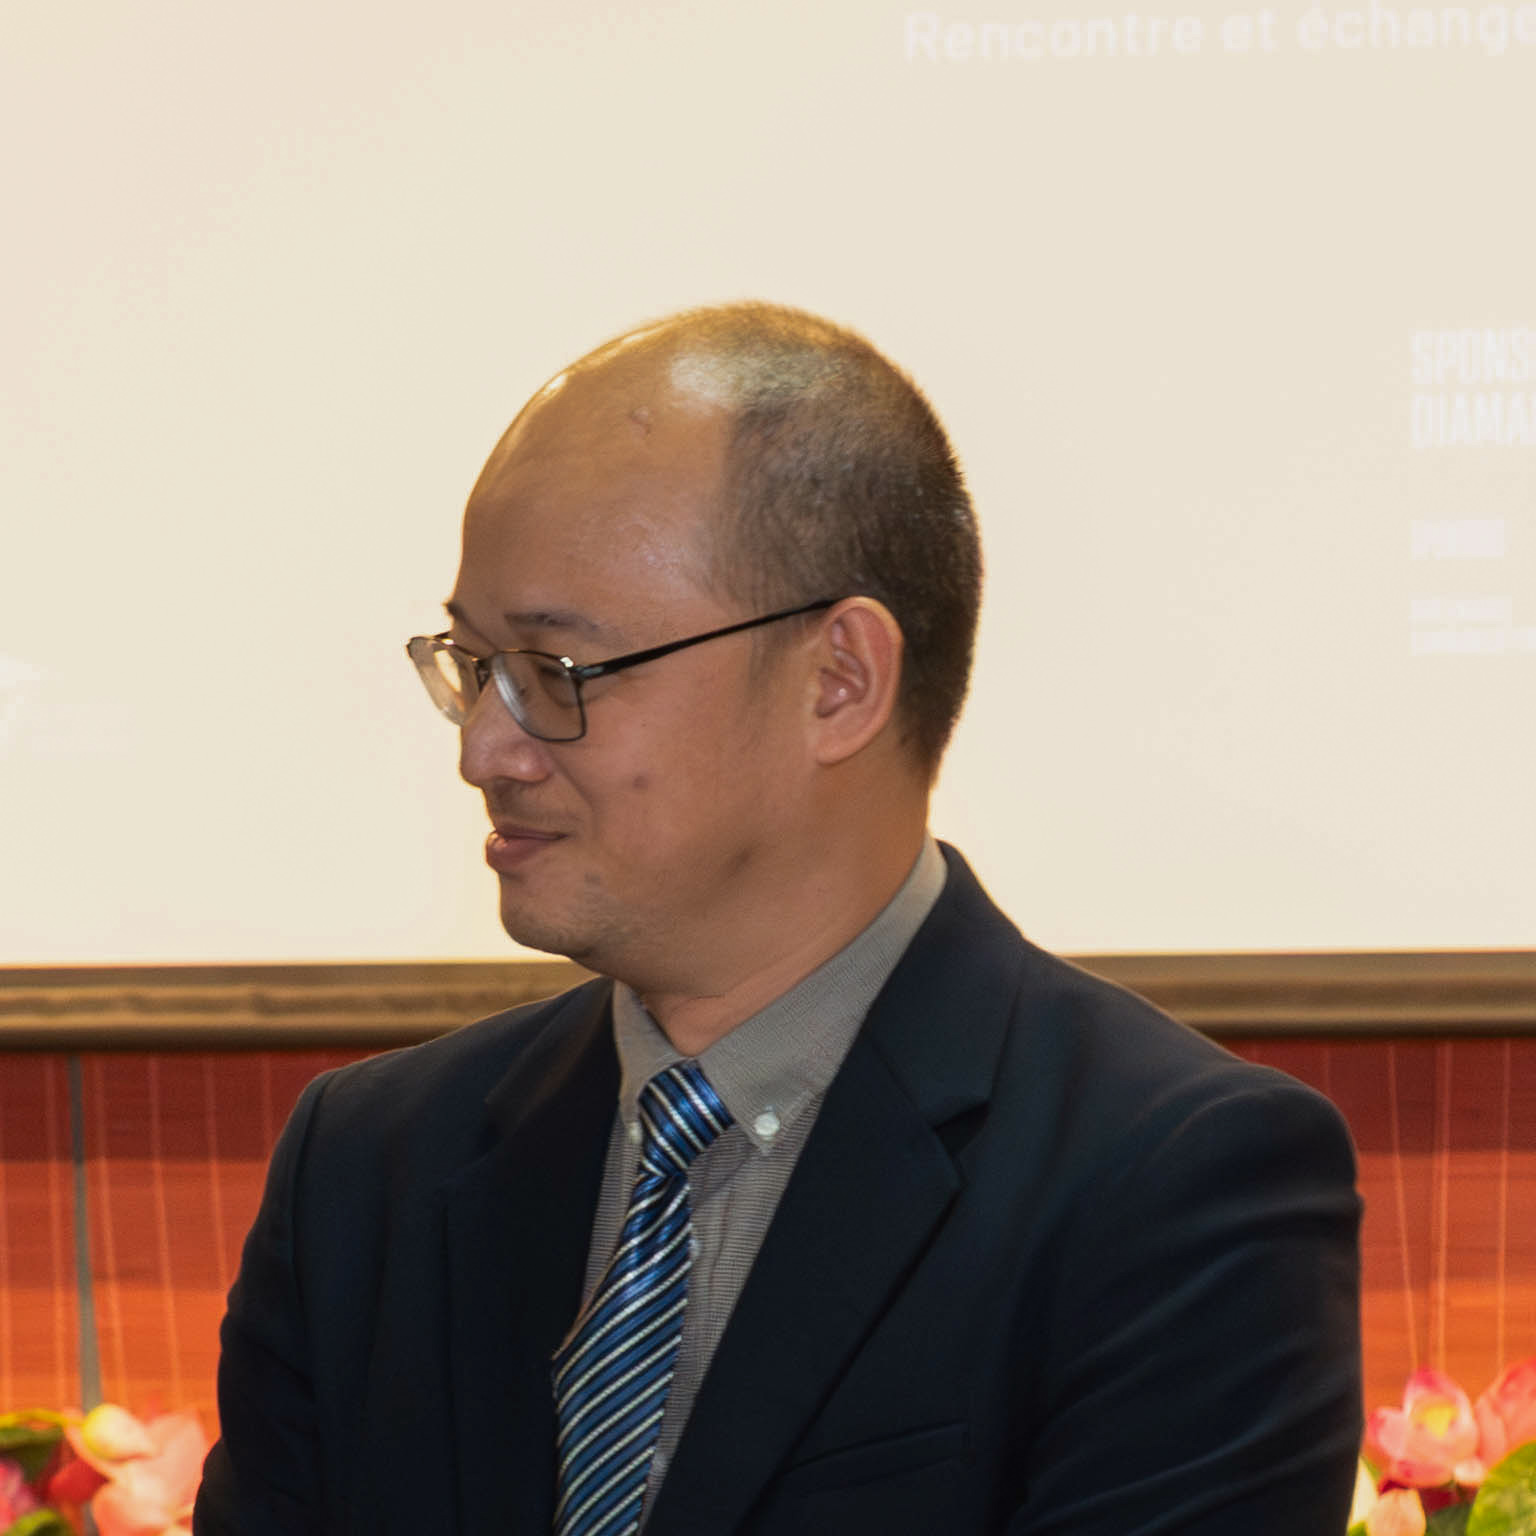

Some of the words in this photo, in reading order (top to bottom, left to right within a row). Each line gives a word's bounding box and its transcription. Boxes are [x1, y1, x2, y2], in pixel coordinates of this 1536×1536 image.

[904, 11, 1203, 62] Rencontre
[1220, 8, 1278, 54] et
[1410, 327, 1536, 386] SPONS
[1410, 391, 1536, 449] DIAMA
